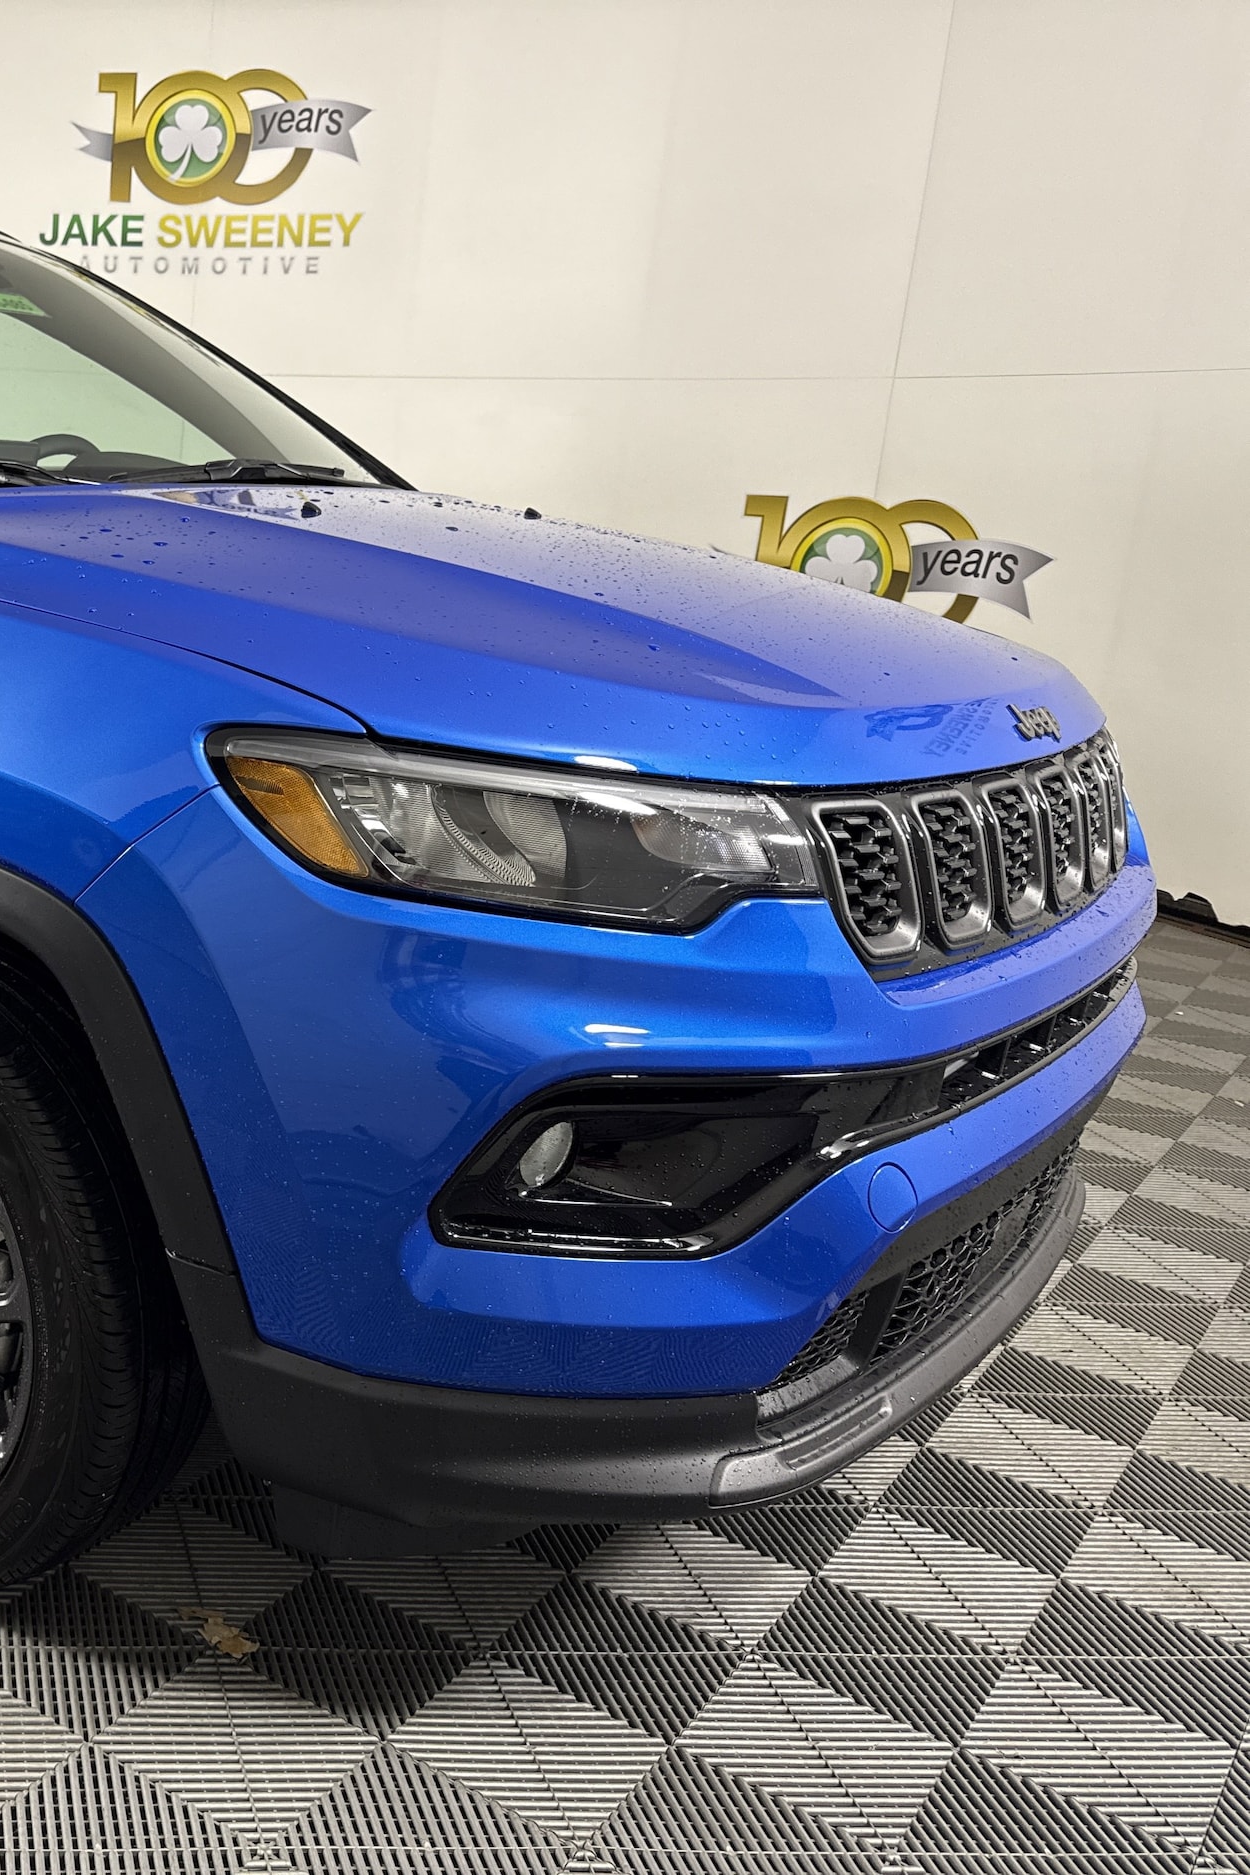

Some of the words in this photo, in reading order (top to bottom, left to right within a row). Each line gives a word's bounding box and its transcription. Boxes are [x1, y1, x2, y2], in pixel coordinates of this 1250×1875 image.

[99, 69, 315, 205] 100
[259, 107, 345, 144] years
[39, 214, 144, 247] JAKE
[157, 213, 364, 248] SWEENEY
[79, 255, 320, 275] AUTOMOTIVE
[916, 549, 1019, 585] years
[1006, 704, 1061, 743] Jeep
